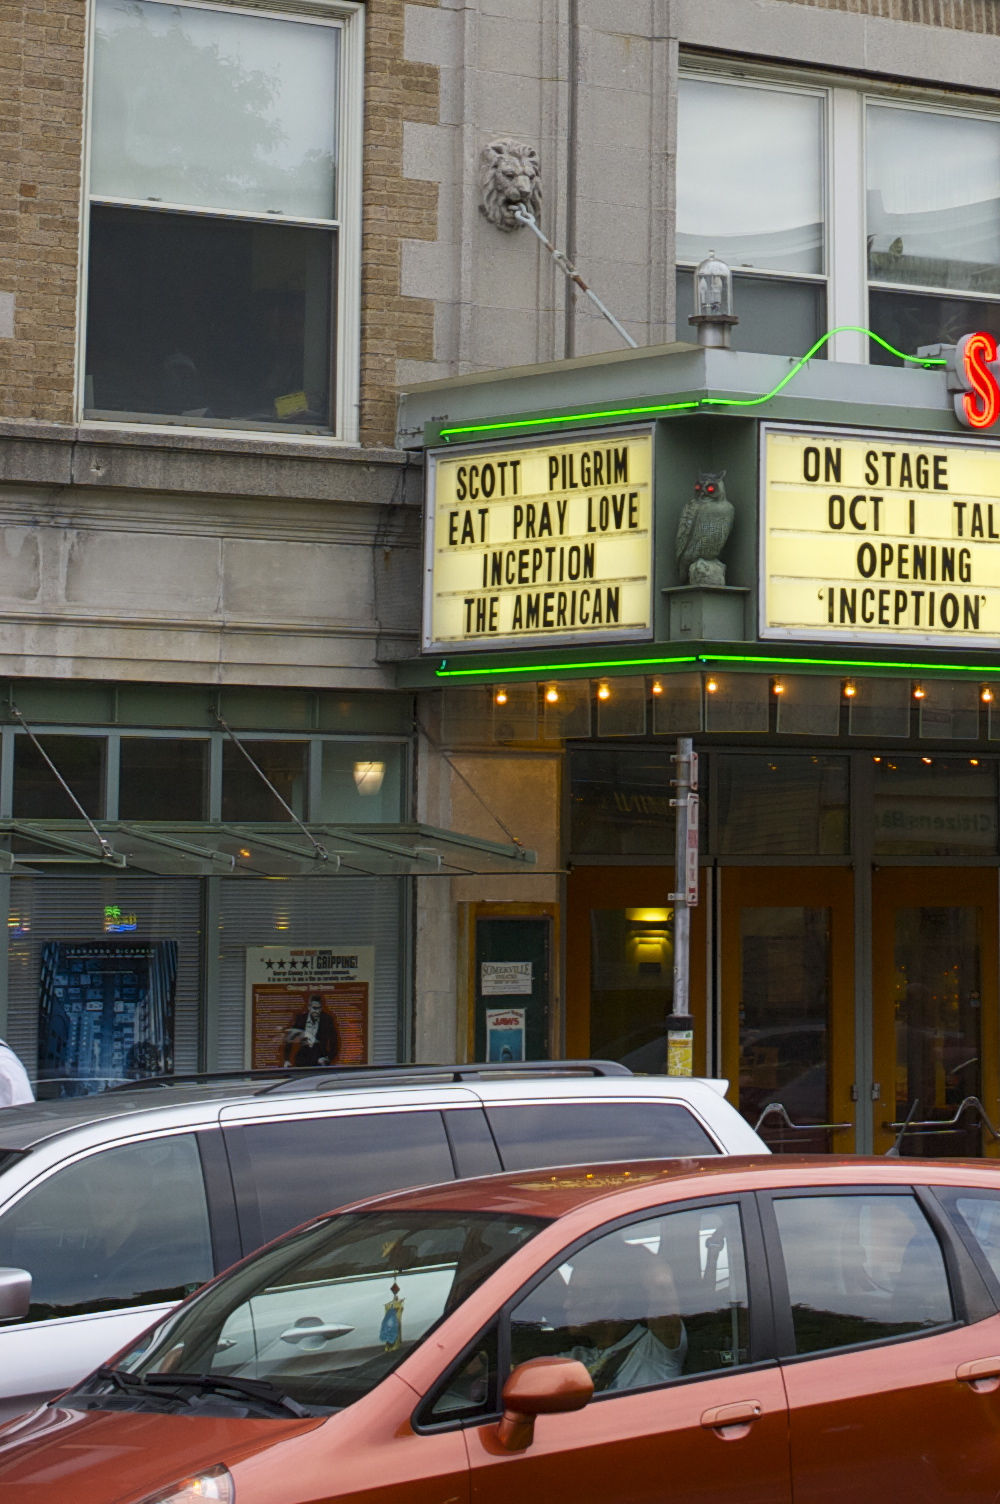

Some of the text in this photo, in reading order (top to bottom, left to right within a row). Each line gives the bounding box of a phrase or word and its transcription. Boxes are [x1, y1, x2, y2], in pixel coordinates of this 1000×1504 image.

[457, 447, 627, 500] SCOTT PILGRIM
[804, 447, 948, 490] ON STAGE
[449, 492, 637, 545] EAT PRAY LOVE
[829, 495, 883, 531] OCT
[483, 543, 594, 587] INCEPTION
[857, 543, 970, 582] OPENING
[465, 587, 619, 633] THE AMERICAN
